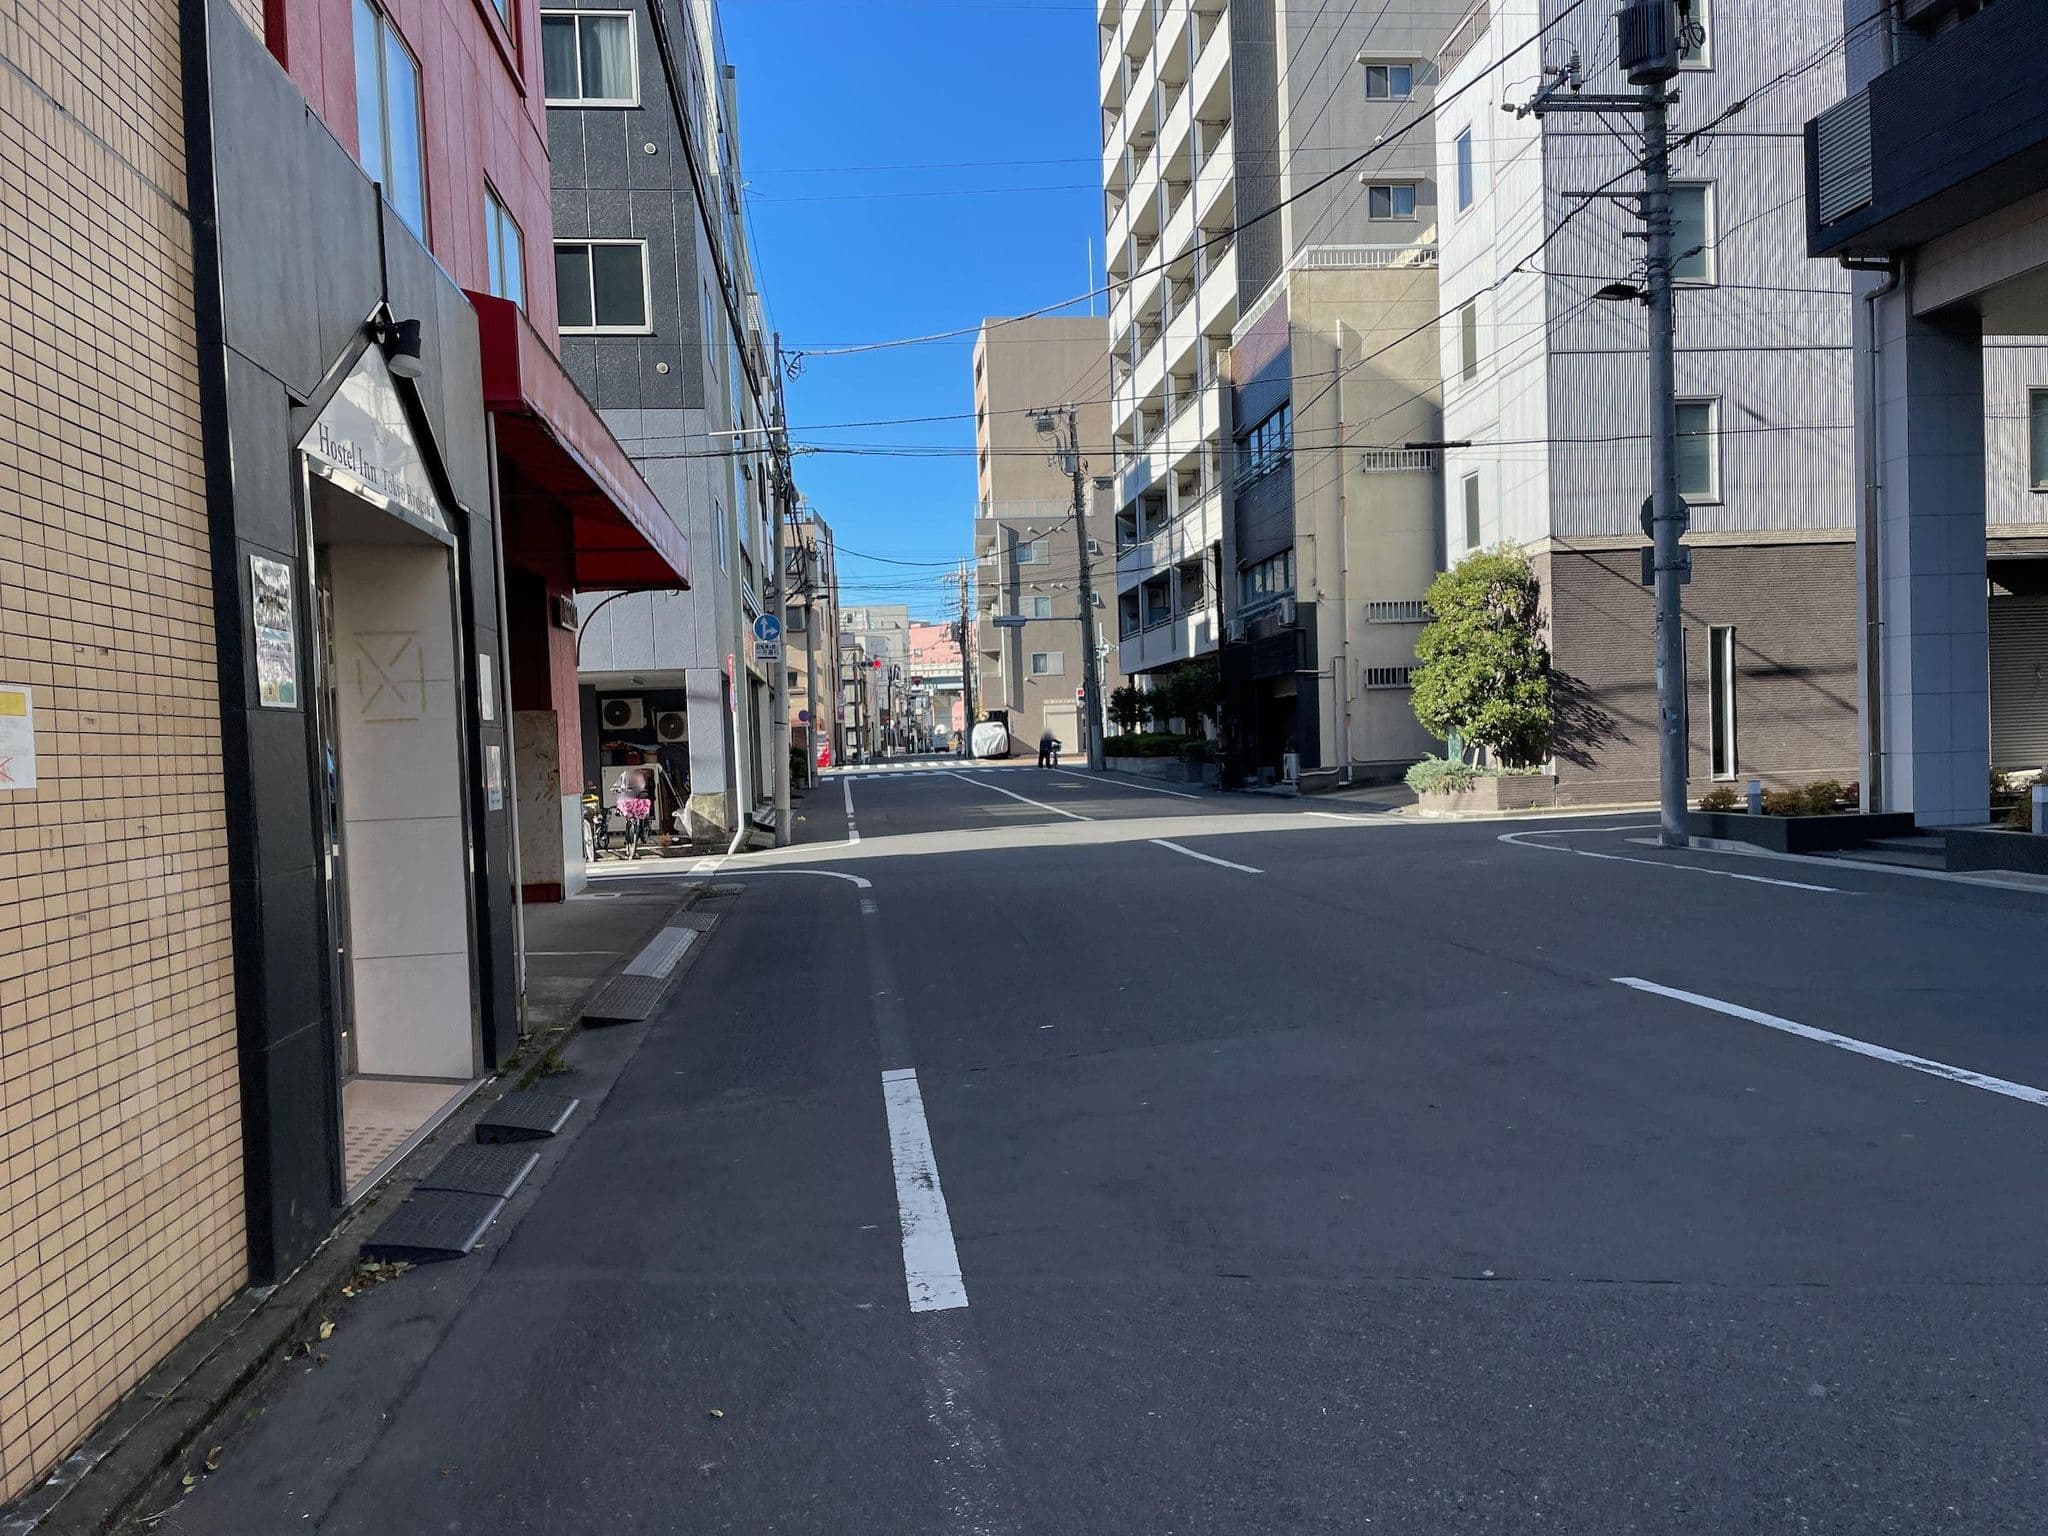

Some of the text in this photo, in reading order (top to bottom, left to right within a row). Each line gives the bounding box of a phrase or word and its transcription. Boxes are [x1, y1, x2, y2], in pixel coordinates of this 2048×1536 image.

[318, 421, 356, 471] Hostel
[358, 447, 378, 484] Inn
[382, 468, 405, 503] Tokyo
